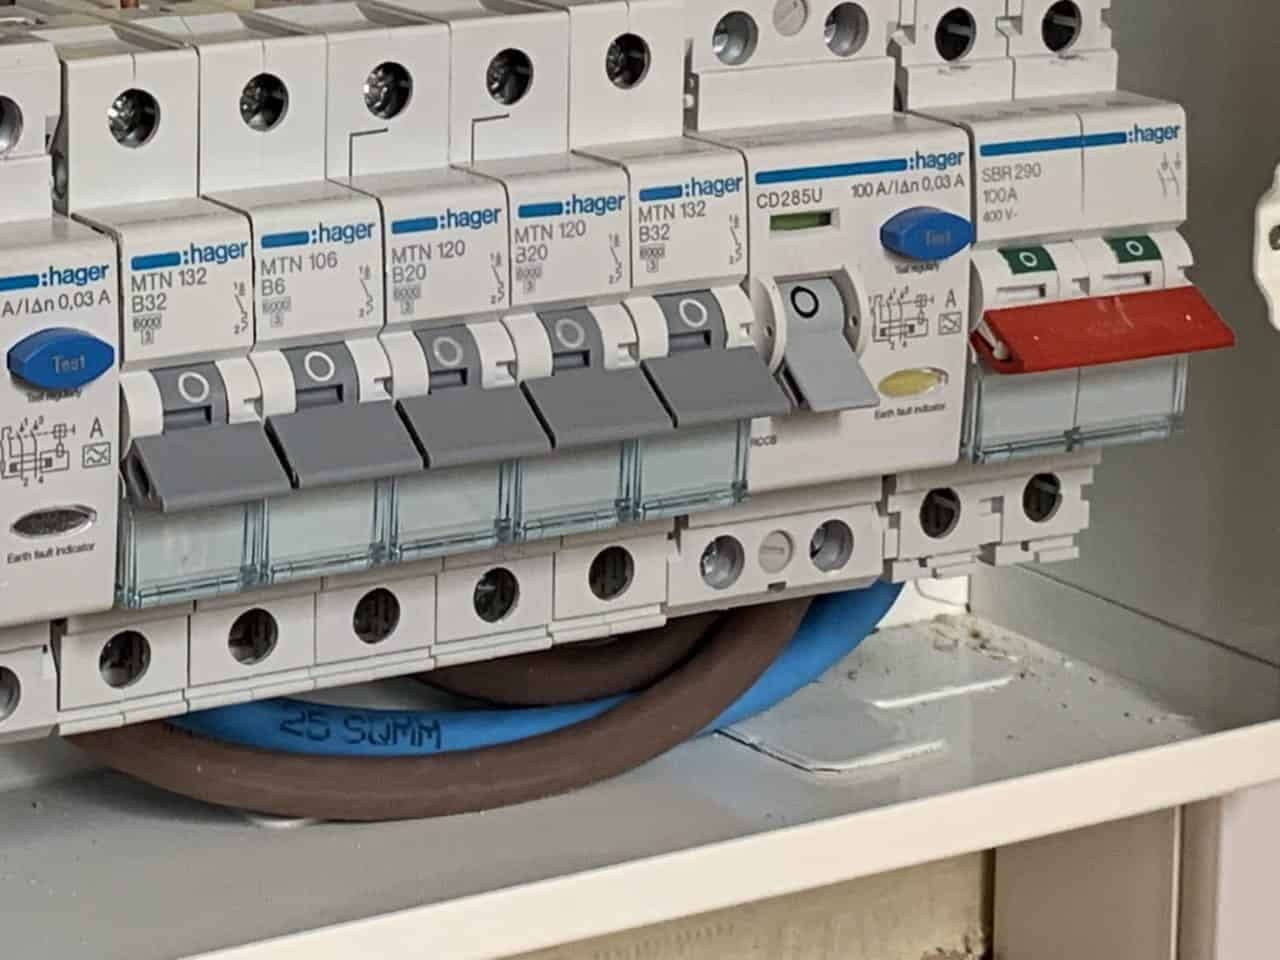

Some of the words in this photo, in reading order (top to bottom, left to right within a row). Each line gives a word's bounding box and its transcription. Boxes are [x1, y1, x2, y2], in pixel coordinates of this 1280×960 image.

[982, 165, 1013, 182] SBR
[1014, 162, 1042, 180] 290
[756, 187, 823, 209] CD285U
[851, 183, 874, 199] 100
[638, 203, 676, 223] MTN
[679, 200, 706, 219] 132
[514, 224, 553, 243] MTN
[558, 219, 586, 239] 120
[639, 224, 670, 243] B32
[392, 242, 432, 264] MTN
[436, 240, 465, 260] 120
[261, 254, 302, 276] MTN
[308, 251, 338, 271] 106
[392, 263, 426, 284] B20
[131, 271, 173, 292] MTN
[177, 267, 208, 287] 132
[261, 278, 286, 296] B6
[132, 292, 167, 313] B32
[279, 707, 331, 741] 25
[343, 714, 442, 749] SQMM
